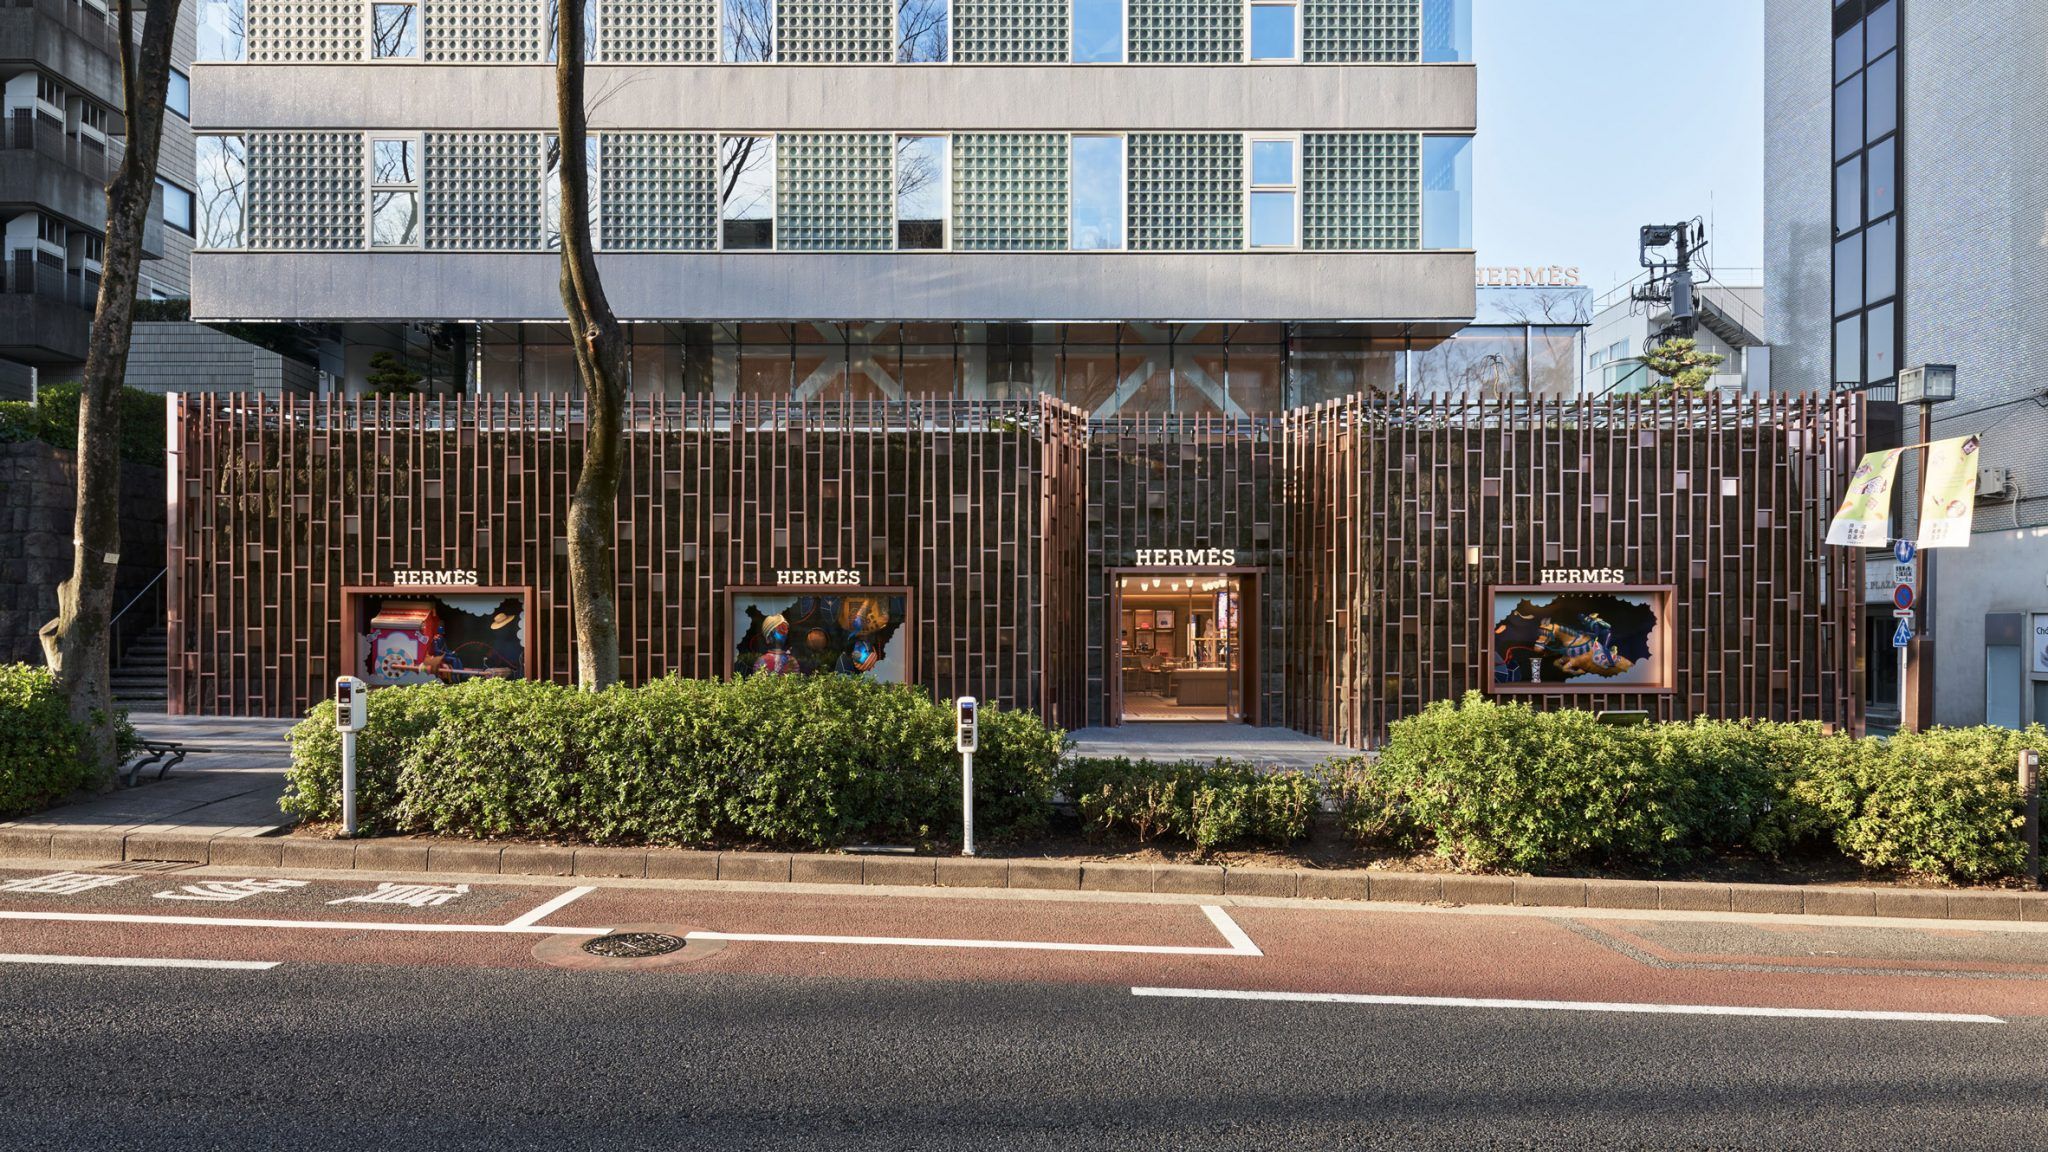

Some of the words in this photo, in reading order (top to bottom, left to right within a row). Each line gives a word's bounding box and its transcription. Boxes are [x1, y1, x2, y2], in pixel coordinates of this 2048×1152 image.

[1136, 547, 1235, 566] HERMÈS
[394, 569, 477, 585] HERMÈS
[777, 569, 860, 585] HERMÈS
[1541, 568, 1624, 584] HERMÈS
